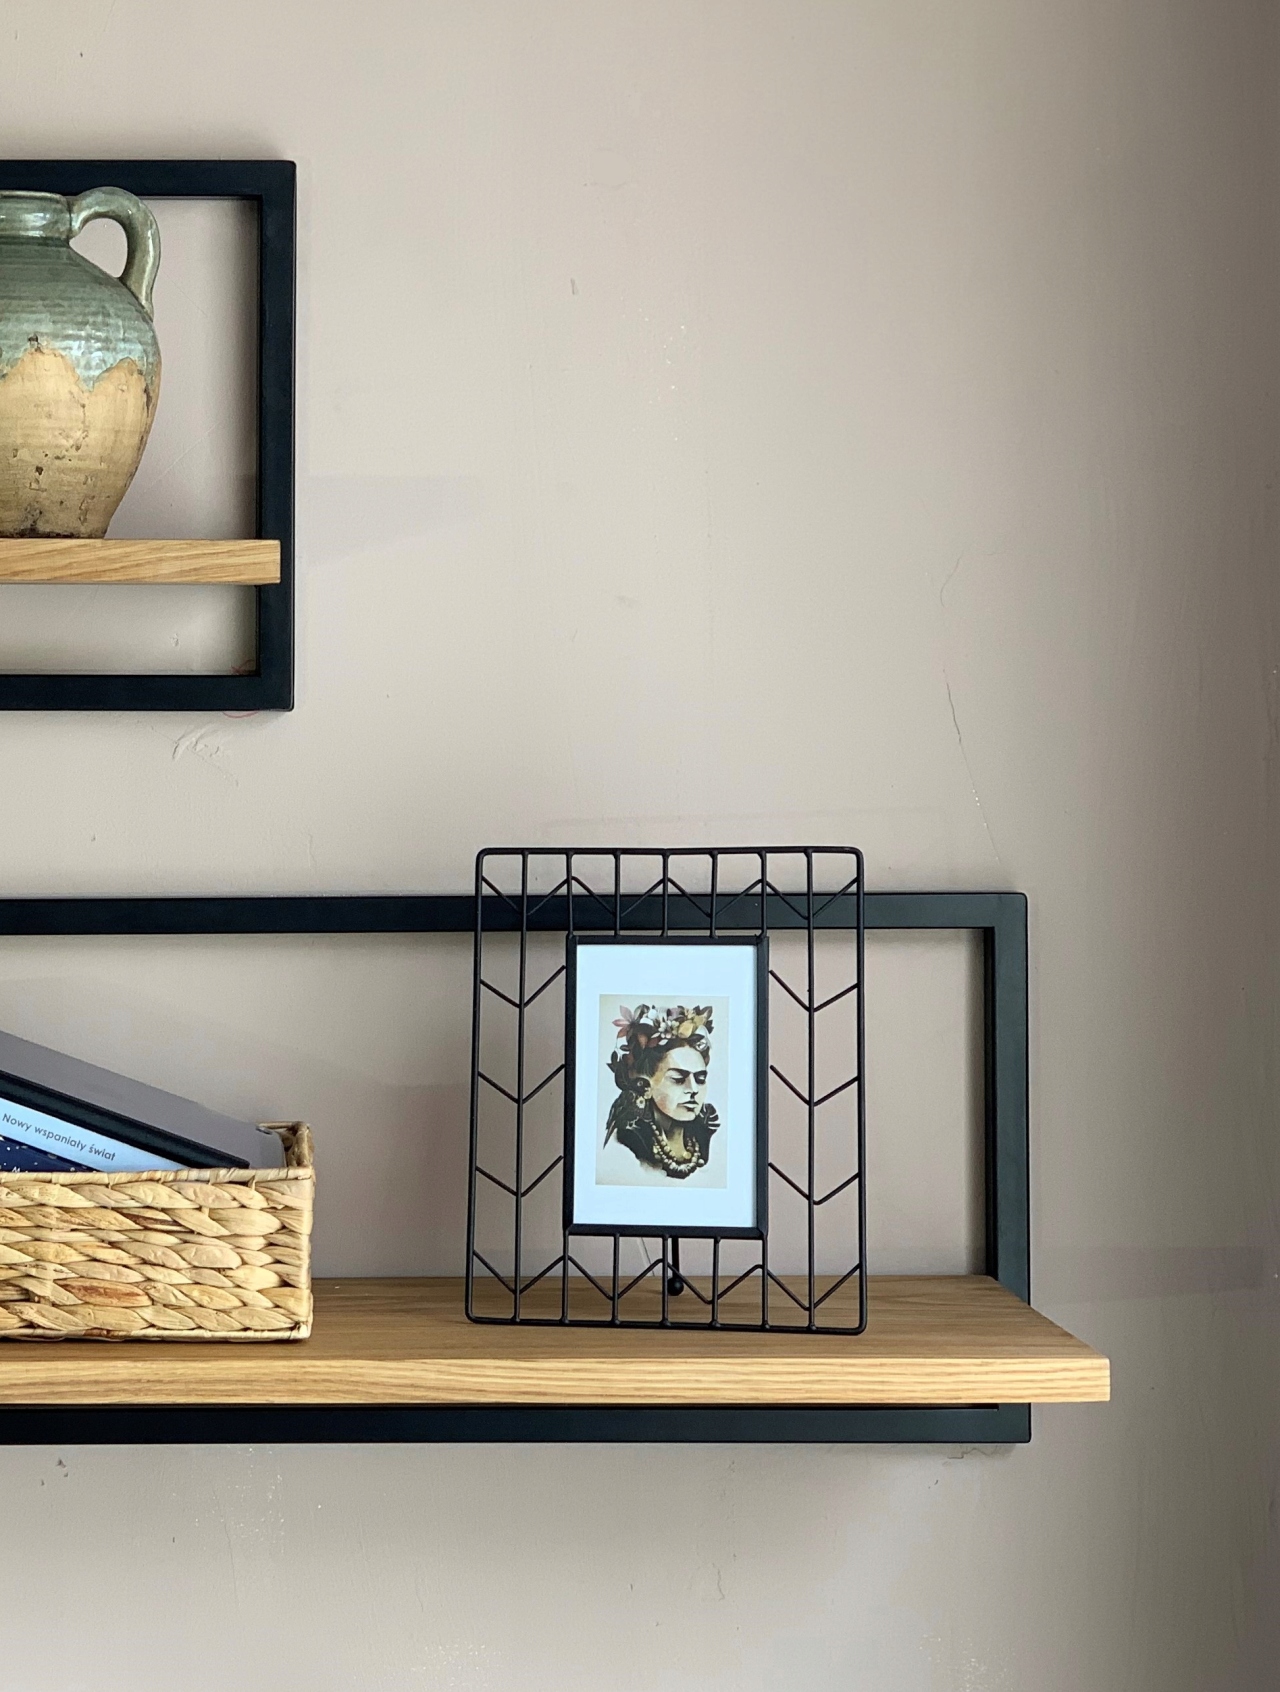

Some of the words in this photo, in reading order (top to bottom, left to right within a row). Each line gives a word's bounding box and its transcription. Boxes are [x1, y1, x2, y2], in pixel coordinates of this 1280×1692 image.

[2, 1113, 32, 1132] Nowy
[34, 1124, 87, 1151] wspaniały
[88, 1143, 116, 1161] świat
